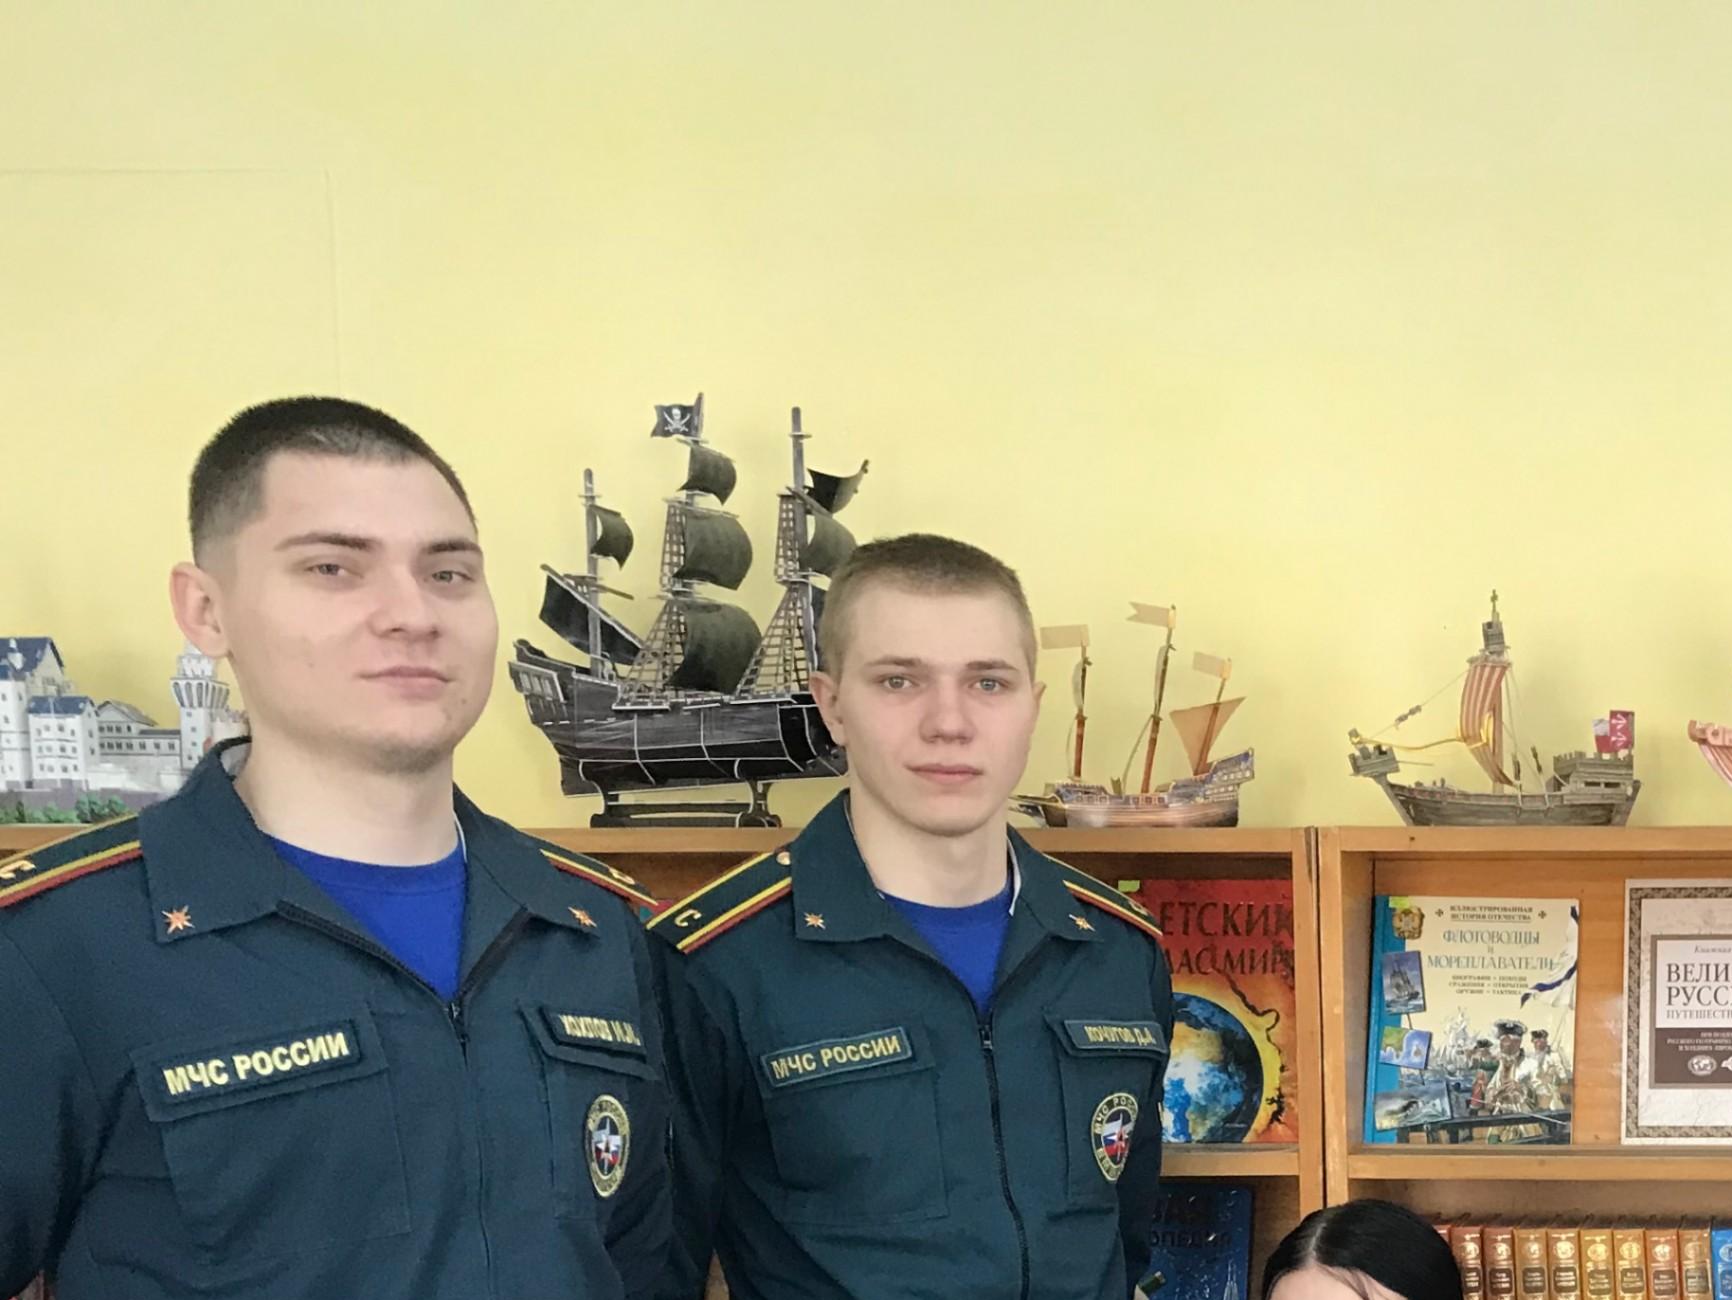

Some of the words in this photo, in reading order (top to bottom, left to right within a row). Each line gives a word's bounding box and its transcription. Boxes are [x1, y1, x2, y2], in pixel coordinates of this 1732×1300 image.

[163, 1058, 229, 1097] МЧС
[233, 1031, 349, 1081] РОССИИ
[770, 1051, 817, 1080] МЧС
[819, 1030, 902, 1066] РОССИИ
